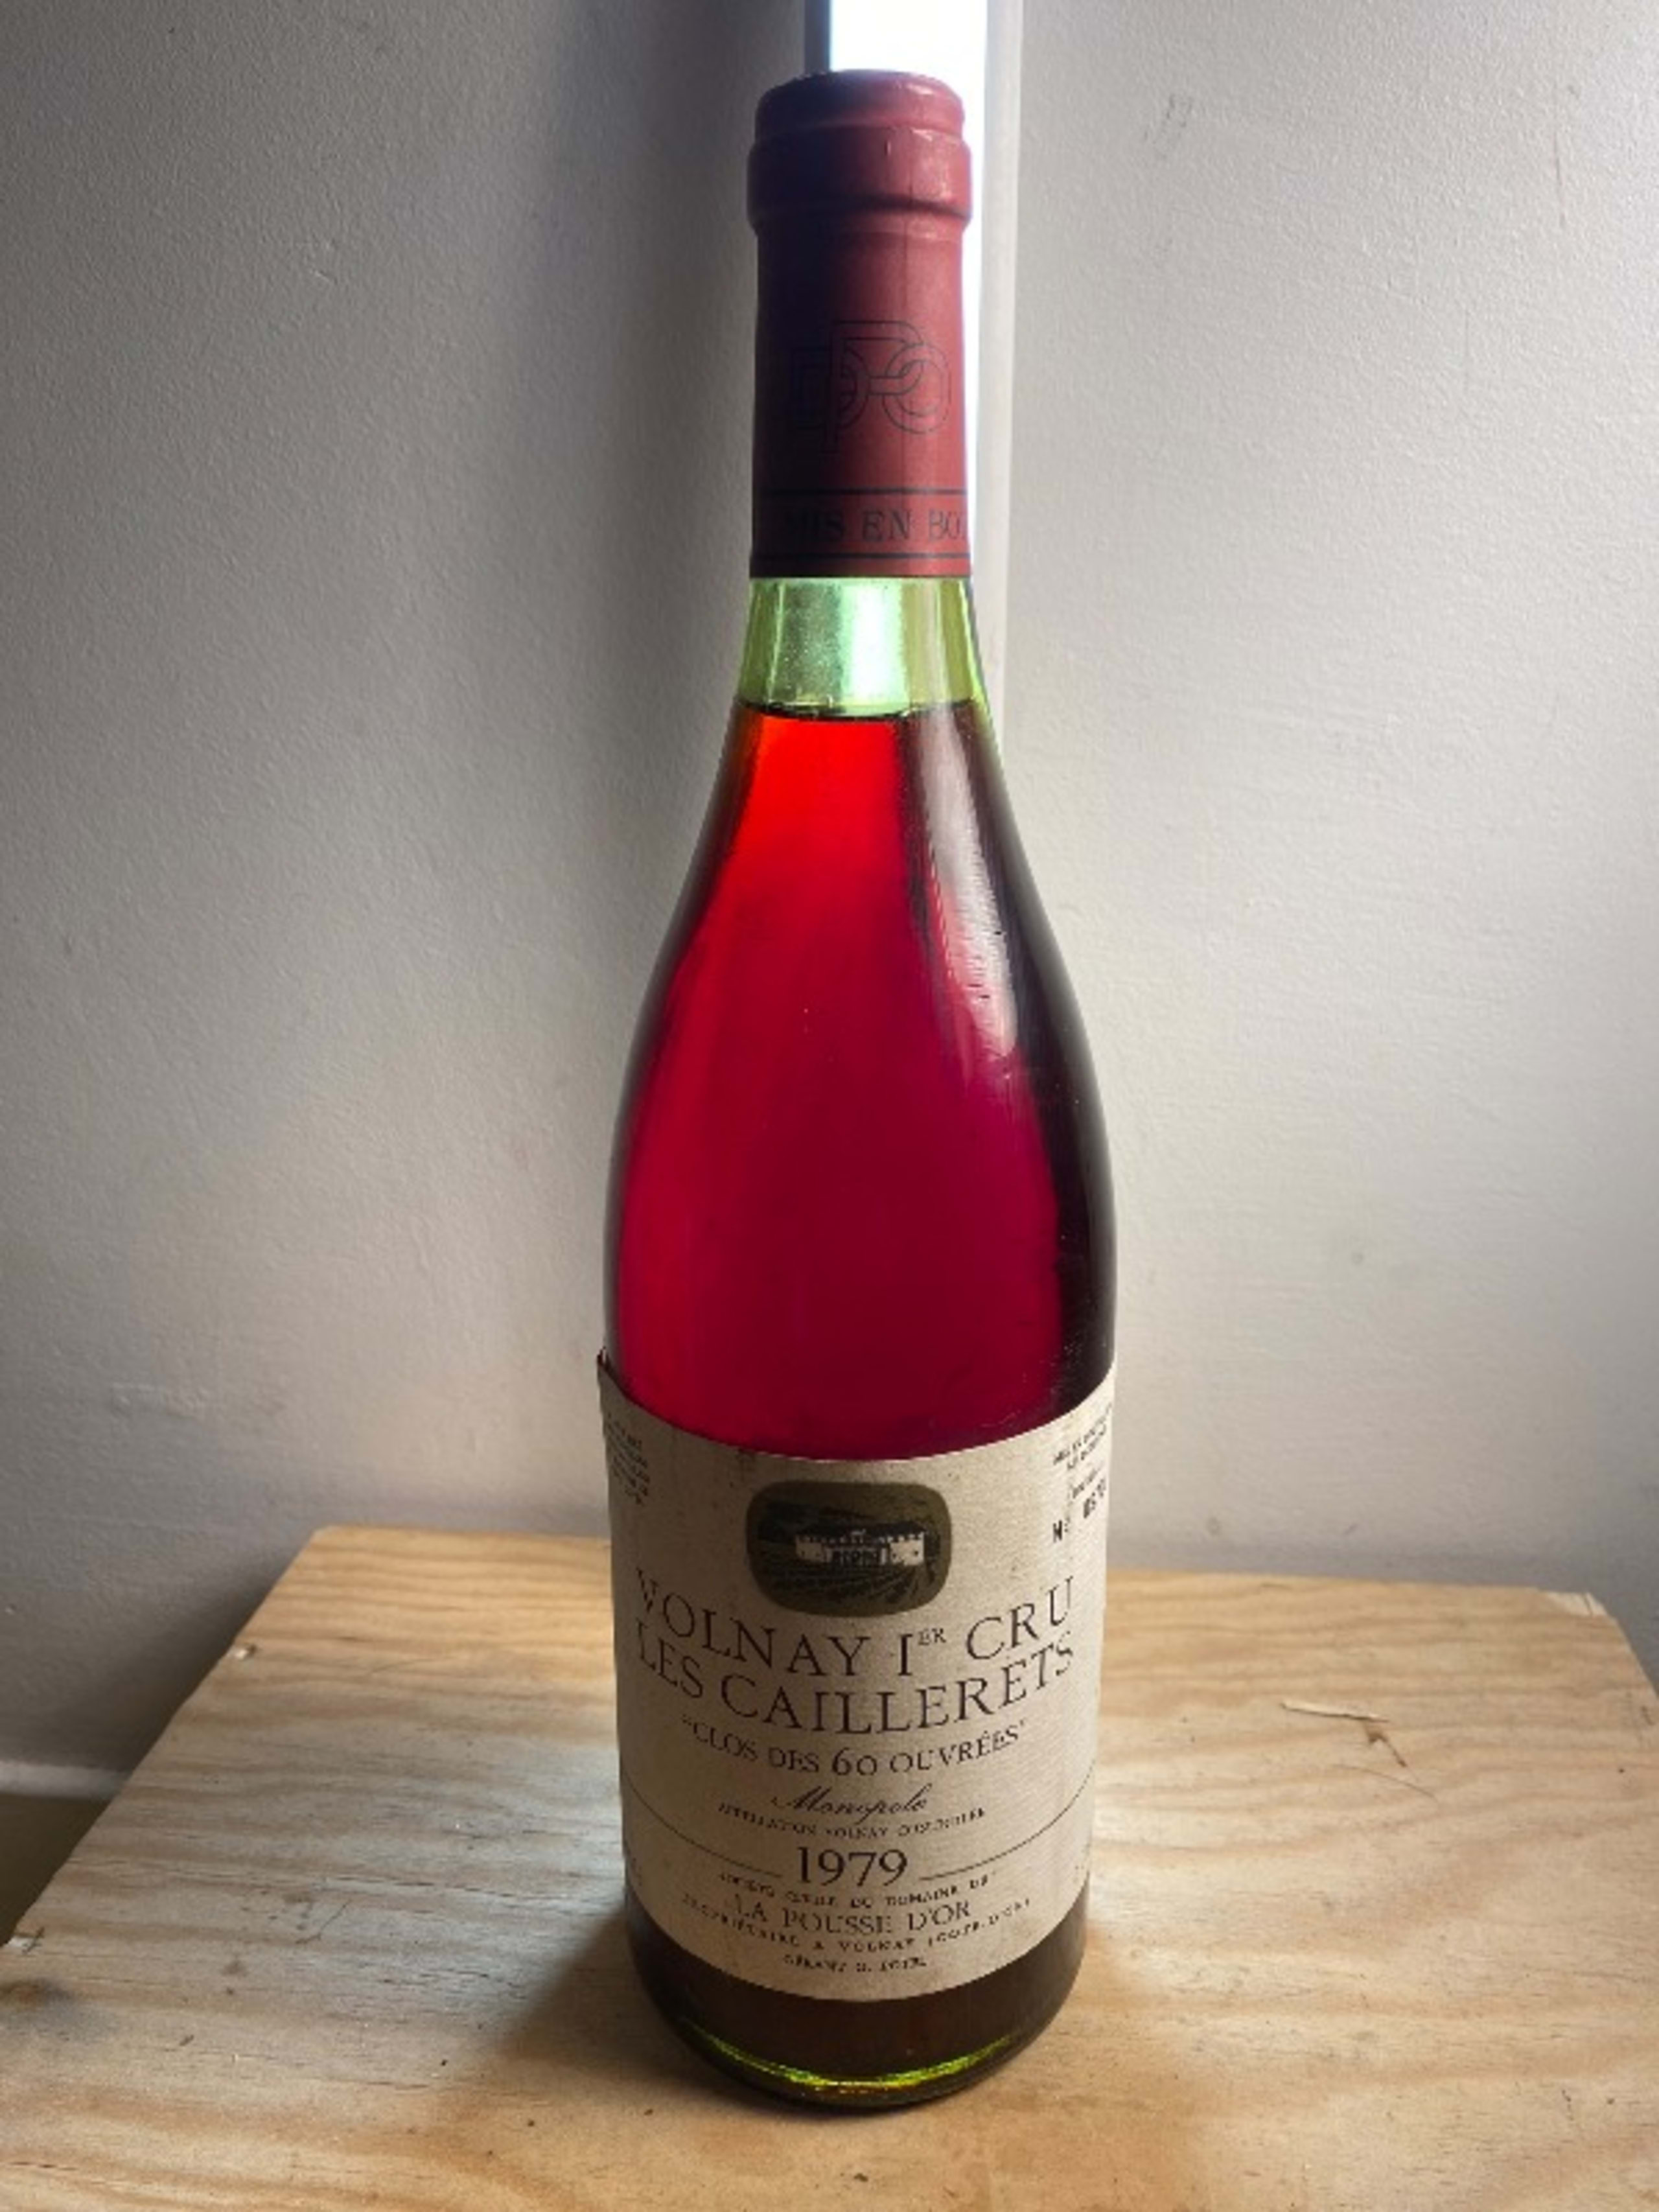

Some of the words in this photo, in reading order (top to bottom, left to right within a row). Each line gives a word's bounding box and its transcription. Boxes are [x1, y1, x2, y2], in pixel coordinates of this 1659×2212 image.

[862, 507, 912, 542] EN
[929, 507, 965, 541] BO
[636, 1566, 871, 1677] VOLNAY
[966, 1575, 1074, 1660] CRU
[636, 1617, 704, 1699] LES
[720, 1629, 1074, 1735] CAILLERETS
[768, 1746, 820, 1773] DES
[831, 1746, 877, 1776] 60
[771, 1782, 933, 1826] Monopole
[798, 1846, 907, 1887] 1979
[734, 1892, 768, 1922] LA
[782, 1906, 893, 1935] POUSSE
[907, 1898, 971, 1931] D'OR
